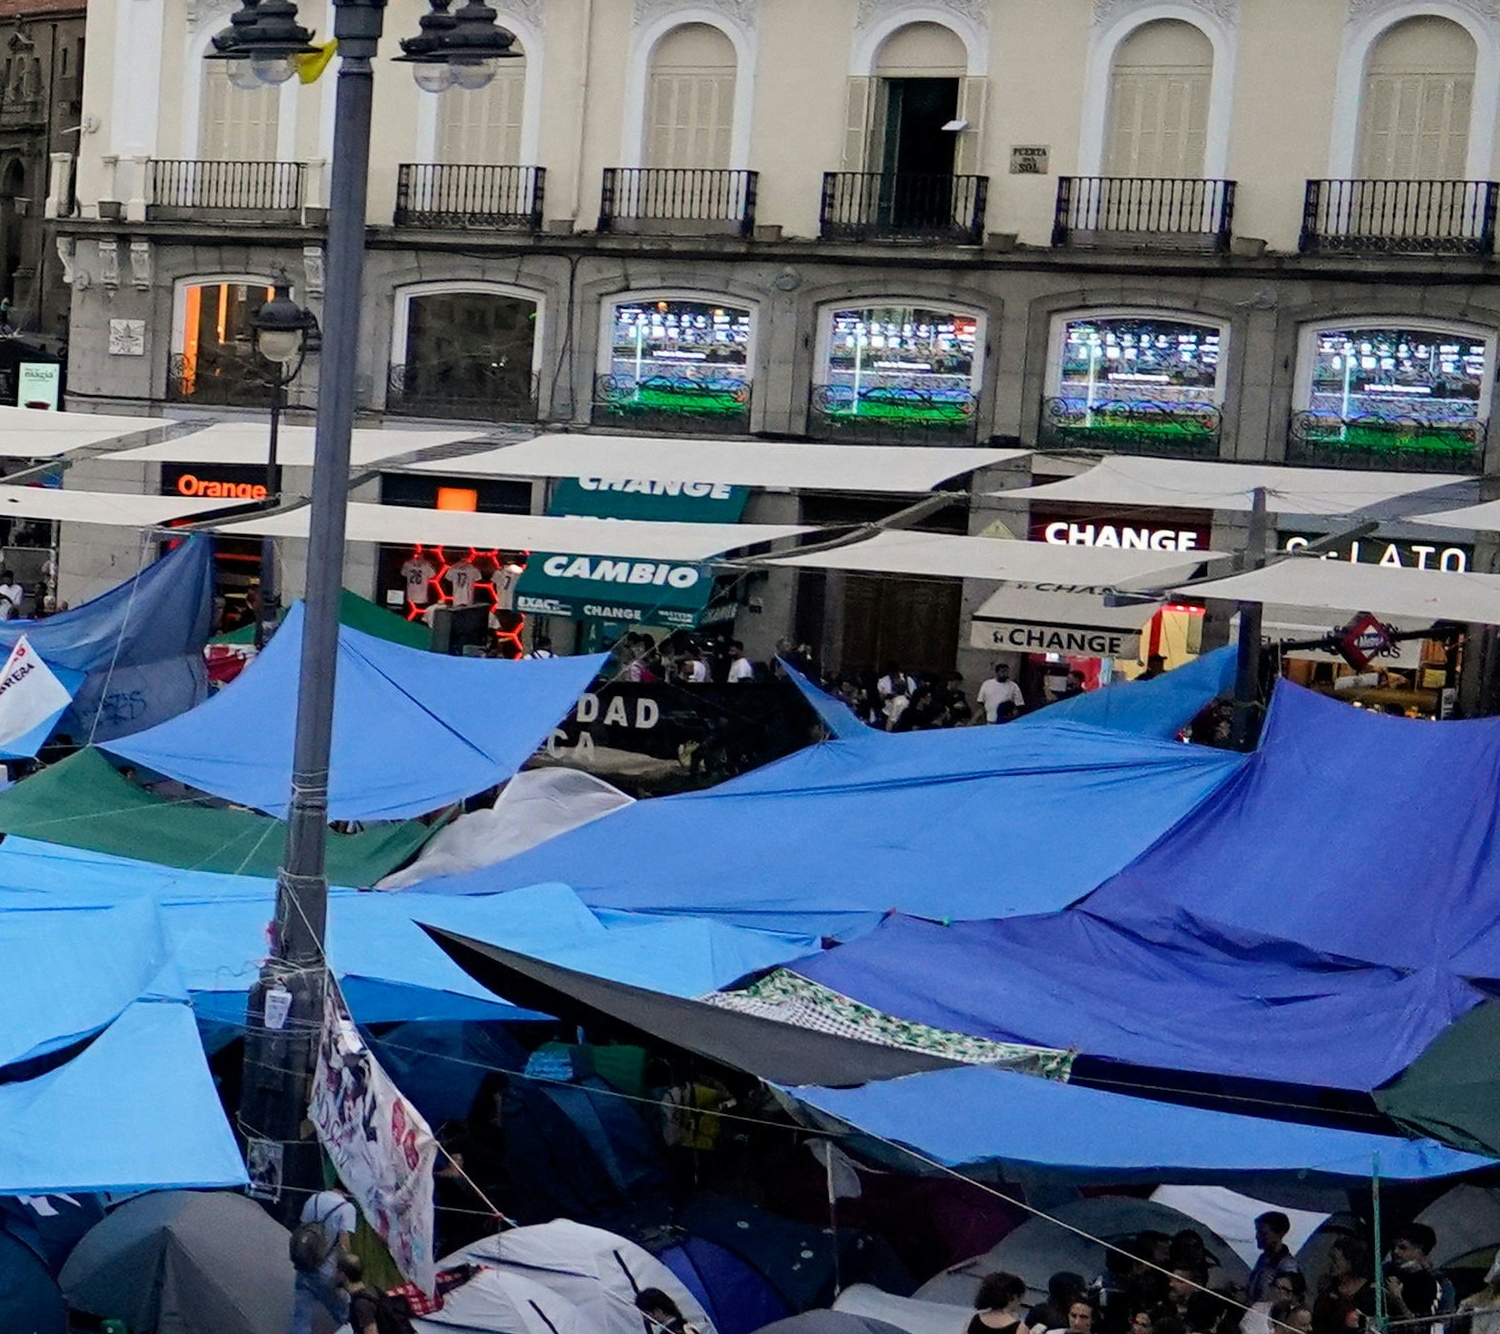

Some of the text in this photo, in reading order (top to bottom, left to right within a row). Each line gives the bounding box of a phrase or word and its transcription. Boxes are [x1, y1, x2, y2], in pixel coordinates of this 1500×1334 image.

[178, 474, 268, 500] Orange
[543, 556, 700, 588] CAMBIO
[583, 604, 642, 620] CHANGE
[1009, 628, 1122, 654] CHANGE
